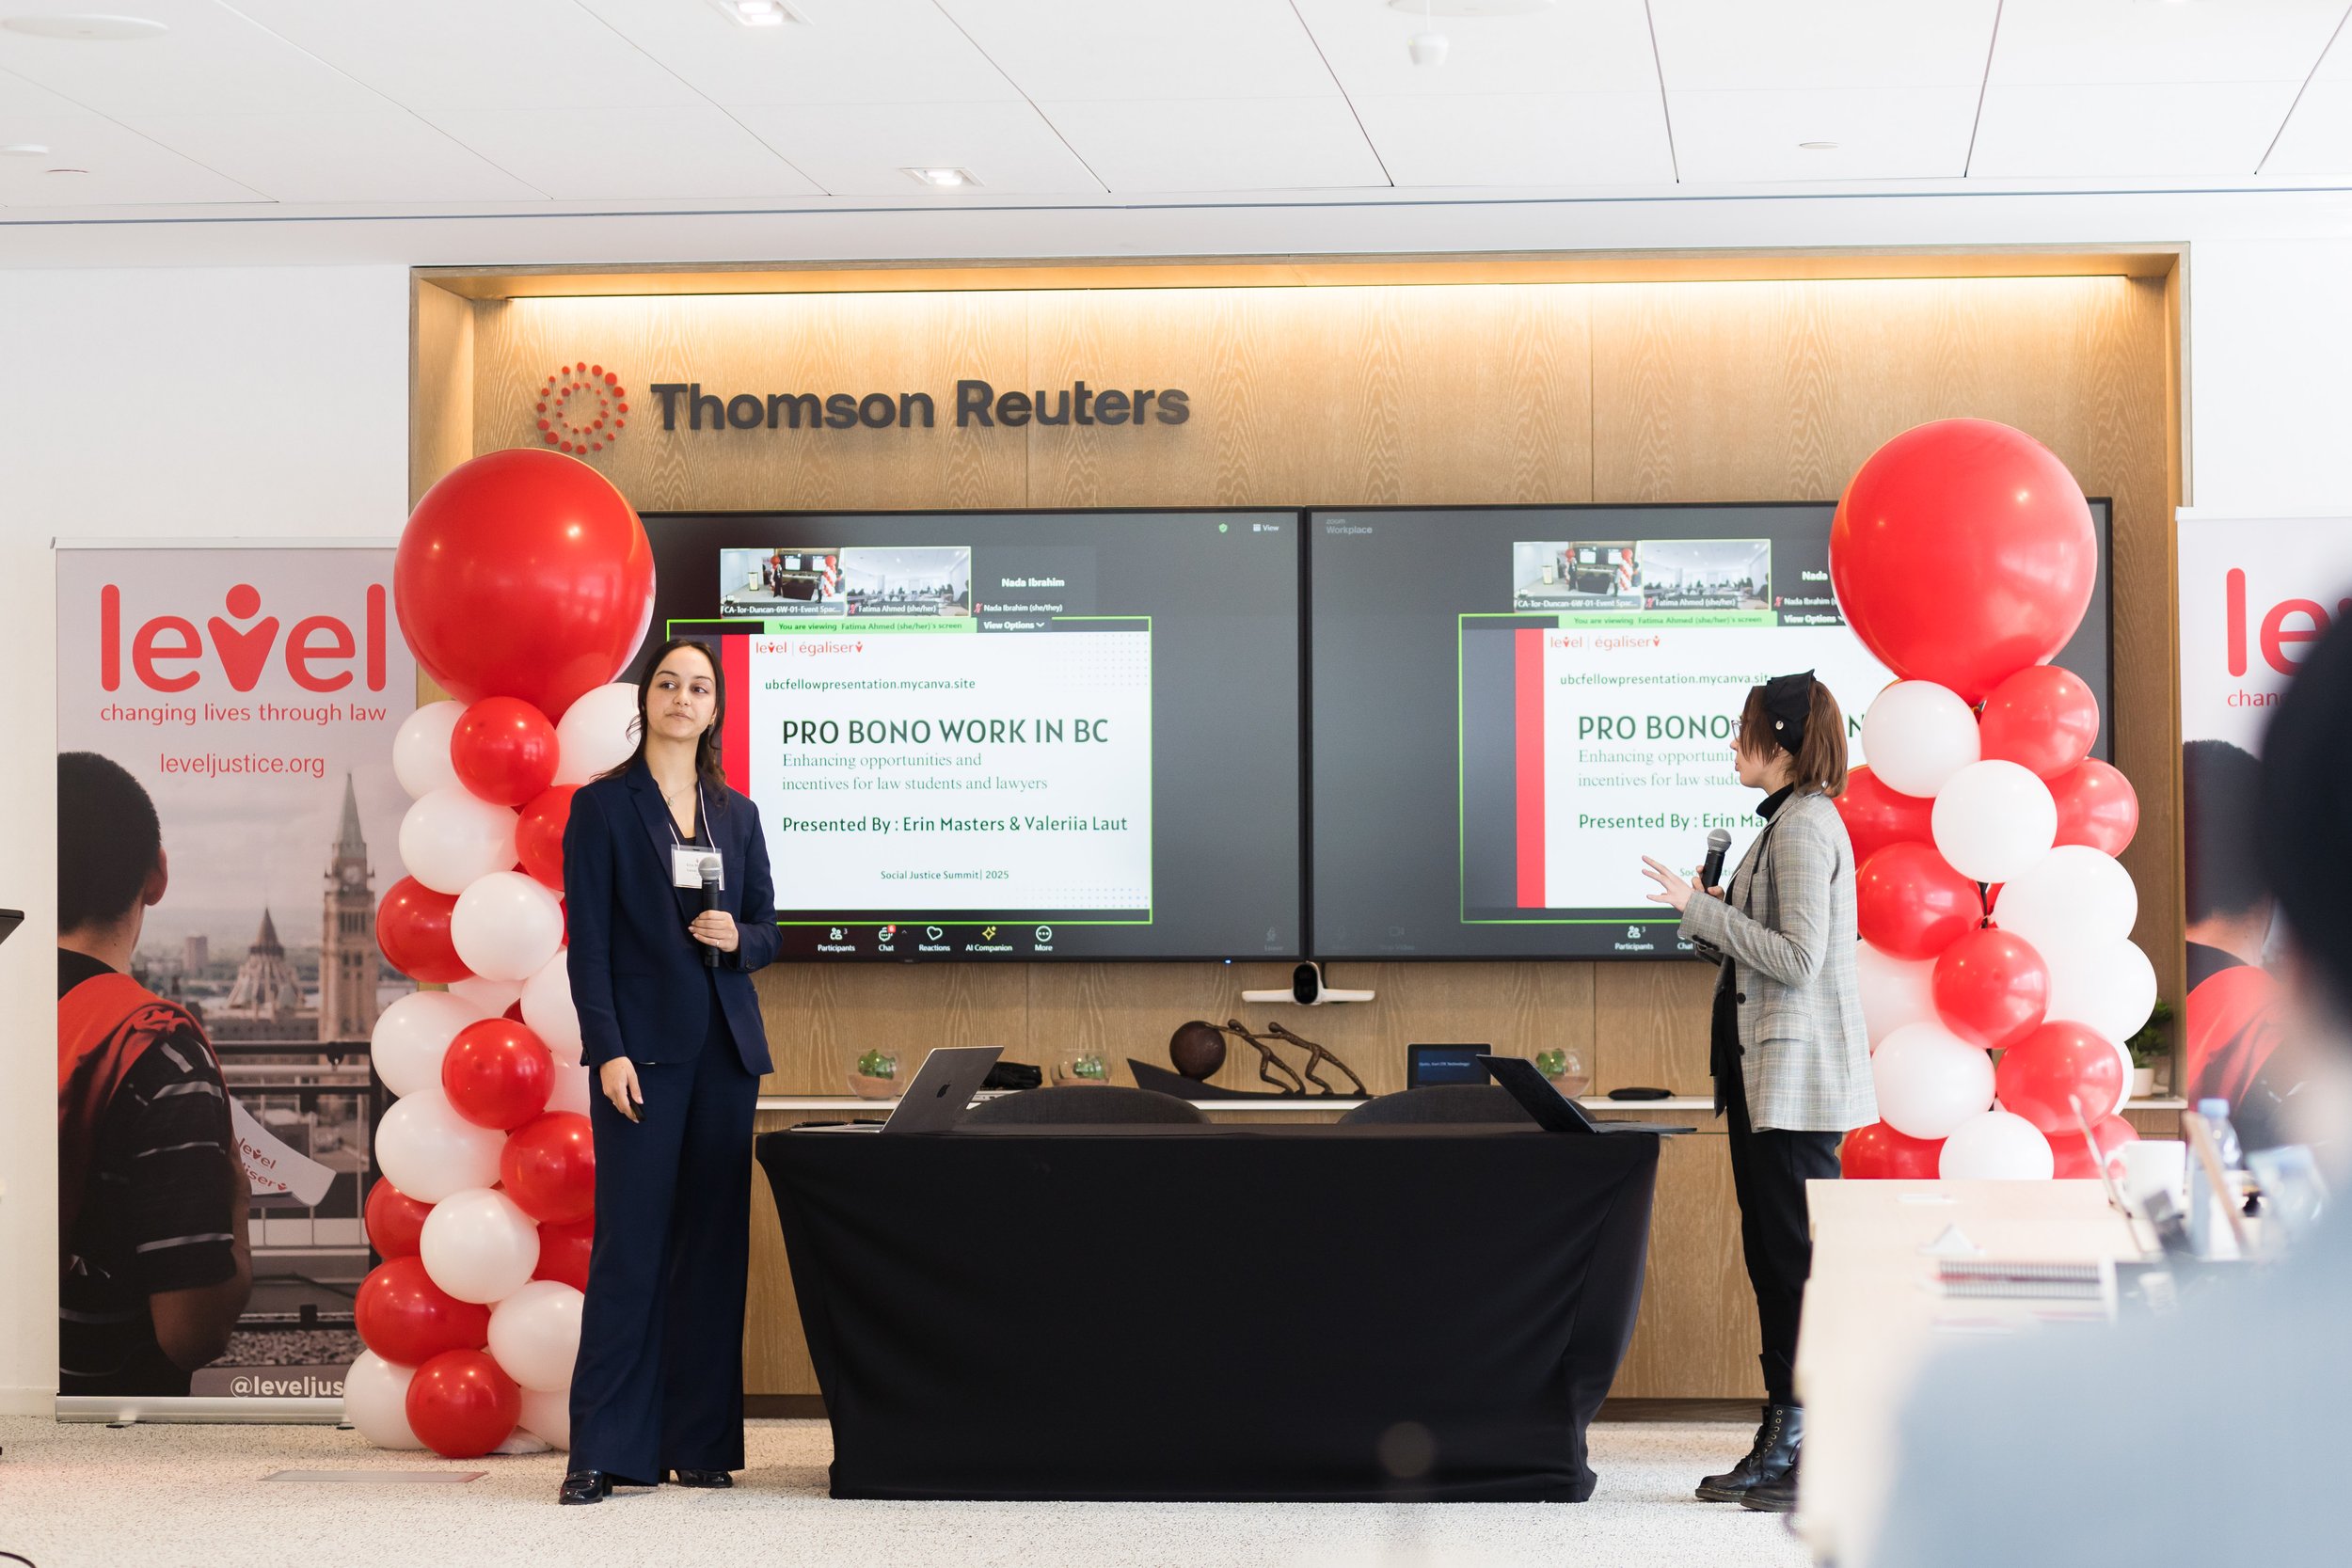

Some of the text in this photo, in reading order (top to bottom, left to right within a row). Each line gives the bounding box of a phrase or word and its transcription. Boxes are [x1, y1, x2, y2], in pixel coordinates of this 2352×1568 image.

[650, 380, 1190, 430] Thomson Reuters
[1326, 526, 1373, 534] Workplace
[1001, 578, 1065, 587] Nada Ibrahim
[1802, 571, 1828, 580] Nada
[907, 605, 936, 613] (she/her)
[984, 621, 1034, 631] View Options
[1604, 617, 1634, 626] viewing
[1784, 614, 1836, 625] View Options
[809, 623, 837, 631] viewing
[101, 583, 387, 692] level
[1550, 637, 1582, 648] level
[755, 641, 787, 654] level
[765, 678, 976, 691] ubcfellowpresentation.mycanva.site
[1560, 673, 1772, 687] ubcfellowpresentation.mycanva.sit
[2228, 689, 2284, 706] chan
[101, 704, 387, 726] changing lives through law
[783, 719, 1108, 744] PRO BONO WORK IN BC
[1579, 716, 1636, 739] PRO
[1646, 715, 1730, 739] BONO
[783, 752, 982, 769] Enhancing opportunities and
[1579, 748, 1733, 765] Enhancing opportunit
[161, 753, 326, 779] leveljustice.org
[783, 776, 1048, 792] incentives for law students and lawyers
[1579, 773, 1646, 786] incentives
[1651, 772, 1671, 785] for
[1676, 772, 1700, 785] law
[783, 816, 866, 832] Presented
[872, 816, 891, 835] By
[903, 816, 935, 832] Erin
[940, 817, 1005, 832] Masters
[1009, 817, 1021, 831] &
[1025, 816, 1088, 831] Valeriia
[1092, 816, 1128, 831] Laut
[1580, 813, 1664, 828] Presented
[1671, 814, 1690, 831] By
[1703, 813, 1735, 827] Erin
[910, 870, 941, 879] Justice
[818, 943, 855, 952] Participants
[975, 943, 1012, 953] Companion
[1615, 942, 1654, 950] Participants
[239, 1138, 276, 1169] level
[230, 1376, 344, 1398] @leveljus
